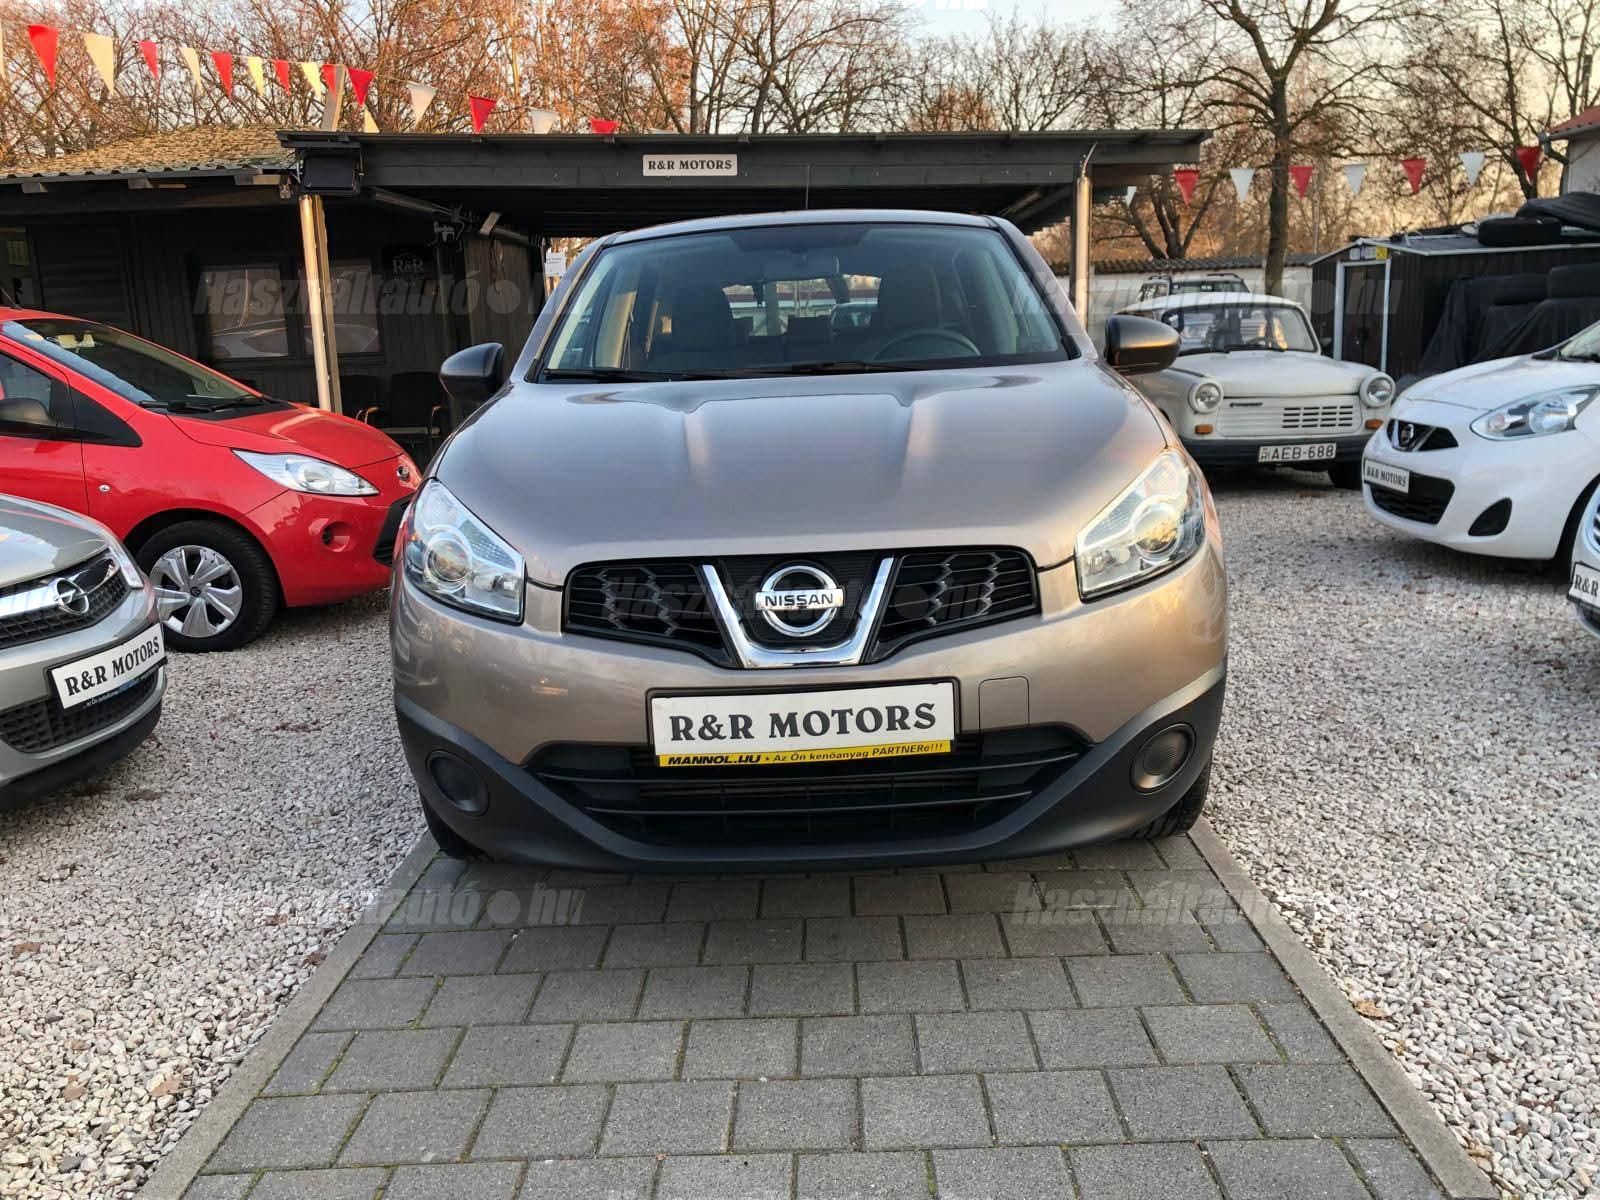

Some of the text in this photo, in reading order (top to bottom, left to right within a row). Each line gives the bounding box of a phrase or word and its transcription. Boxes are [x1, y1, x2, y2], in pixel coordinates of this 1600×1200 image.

[648, 159, 733, 170] R&R MOTORS
[1271, 445, 1334, 461] AEB-688
[1380, 470, 1407, 488] MOTORS
[1574, 573, 1599, 598] R&R
[765, 593, 834, 607] NISSAN
[64, 665, 107, 696] R&R
[111, 636, 160, 678] MOTORS
[669, 702, 937, 741] R&R MOTORS
[667, 755, 762, 765] MANNOL.HU
[773, 754, 787, 762] Az
